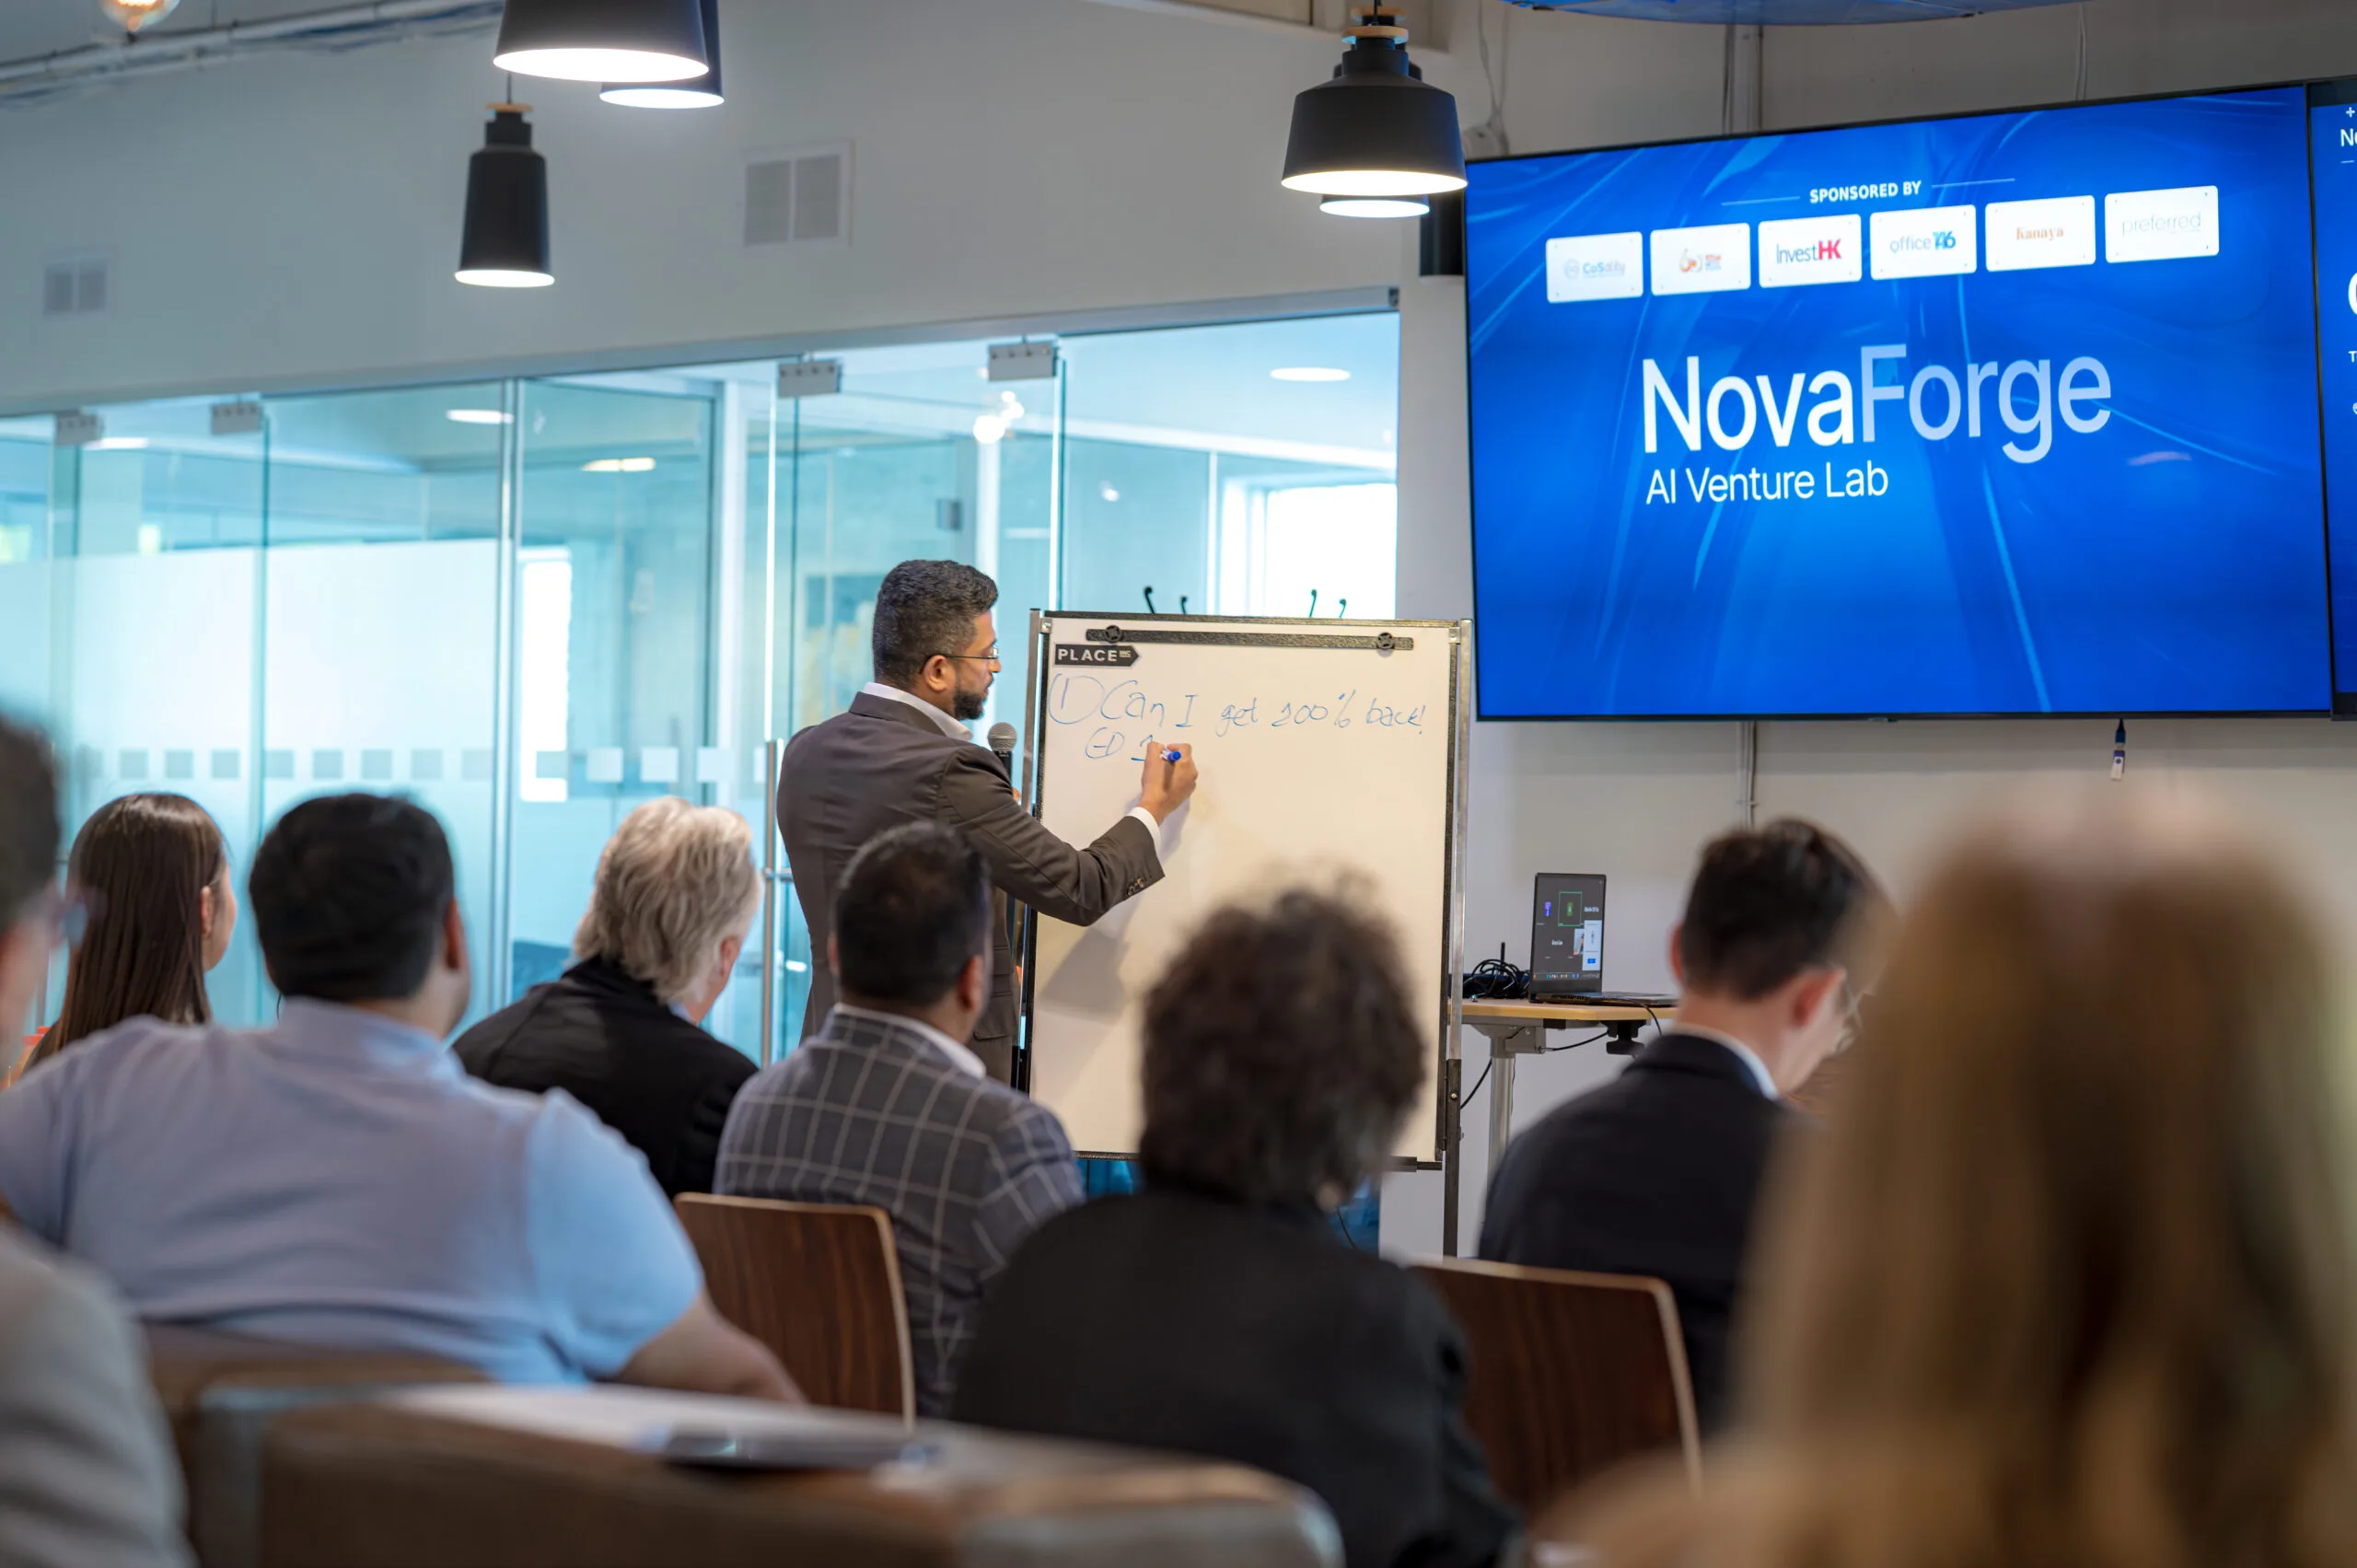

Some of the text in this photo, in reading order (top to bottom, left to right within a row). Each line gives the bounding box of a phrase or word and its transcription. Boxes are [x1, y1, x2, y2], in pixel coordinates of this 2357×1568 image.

[1809, 180, 1922, 203] SPONSORED BY
[2121, 212, 2201, 238] preferred
[1776, 238, 1842, 264] InvestHK
[1643, 343, 2112, 463] NovaForge
[1646, 459, 1888, 504] AI Venture Lab
[1057, 648, 1118, 662] PLACE
[1100, 679, 1166, 727] Can
[1175, 694, 1199, 727] I
